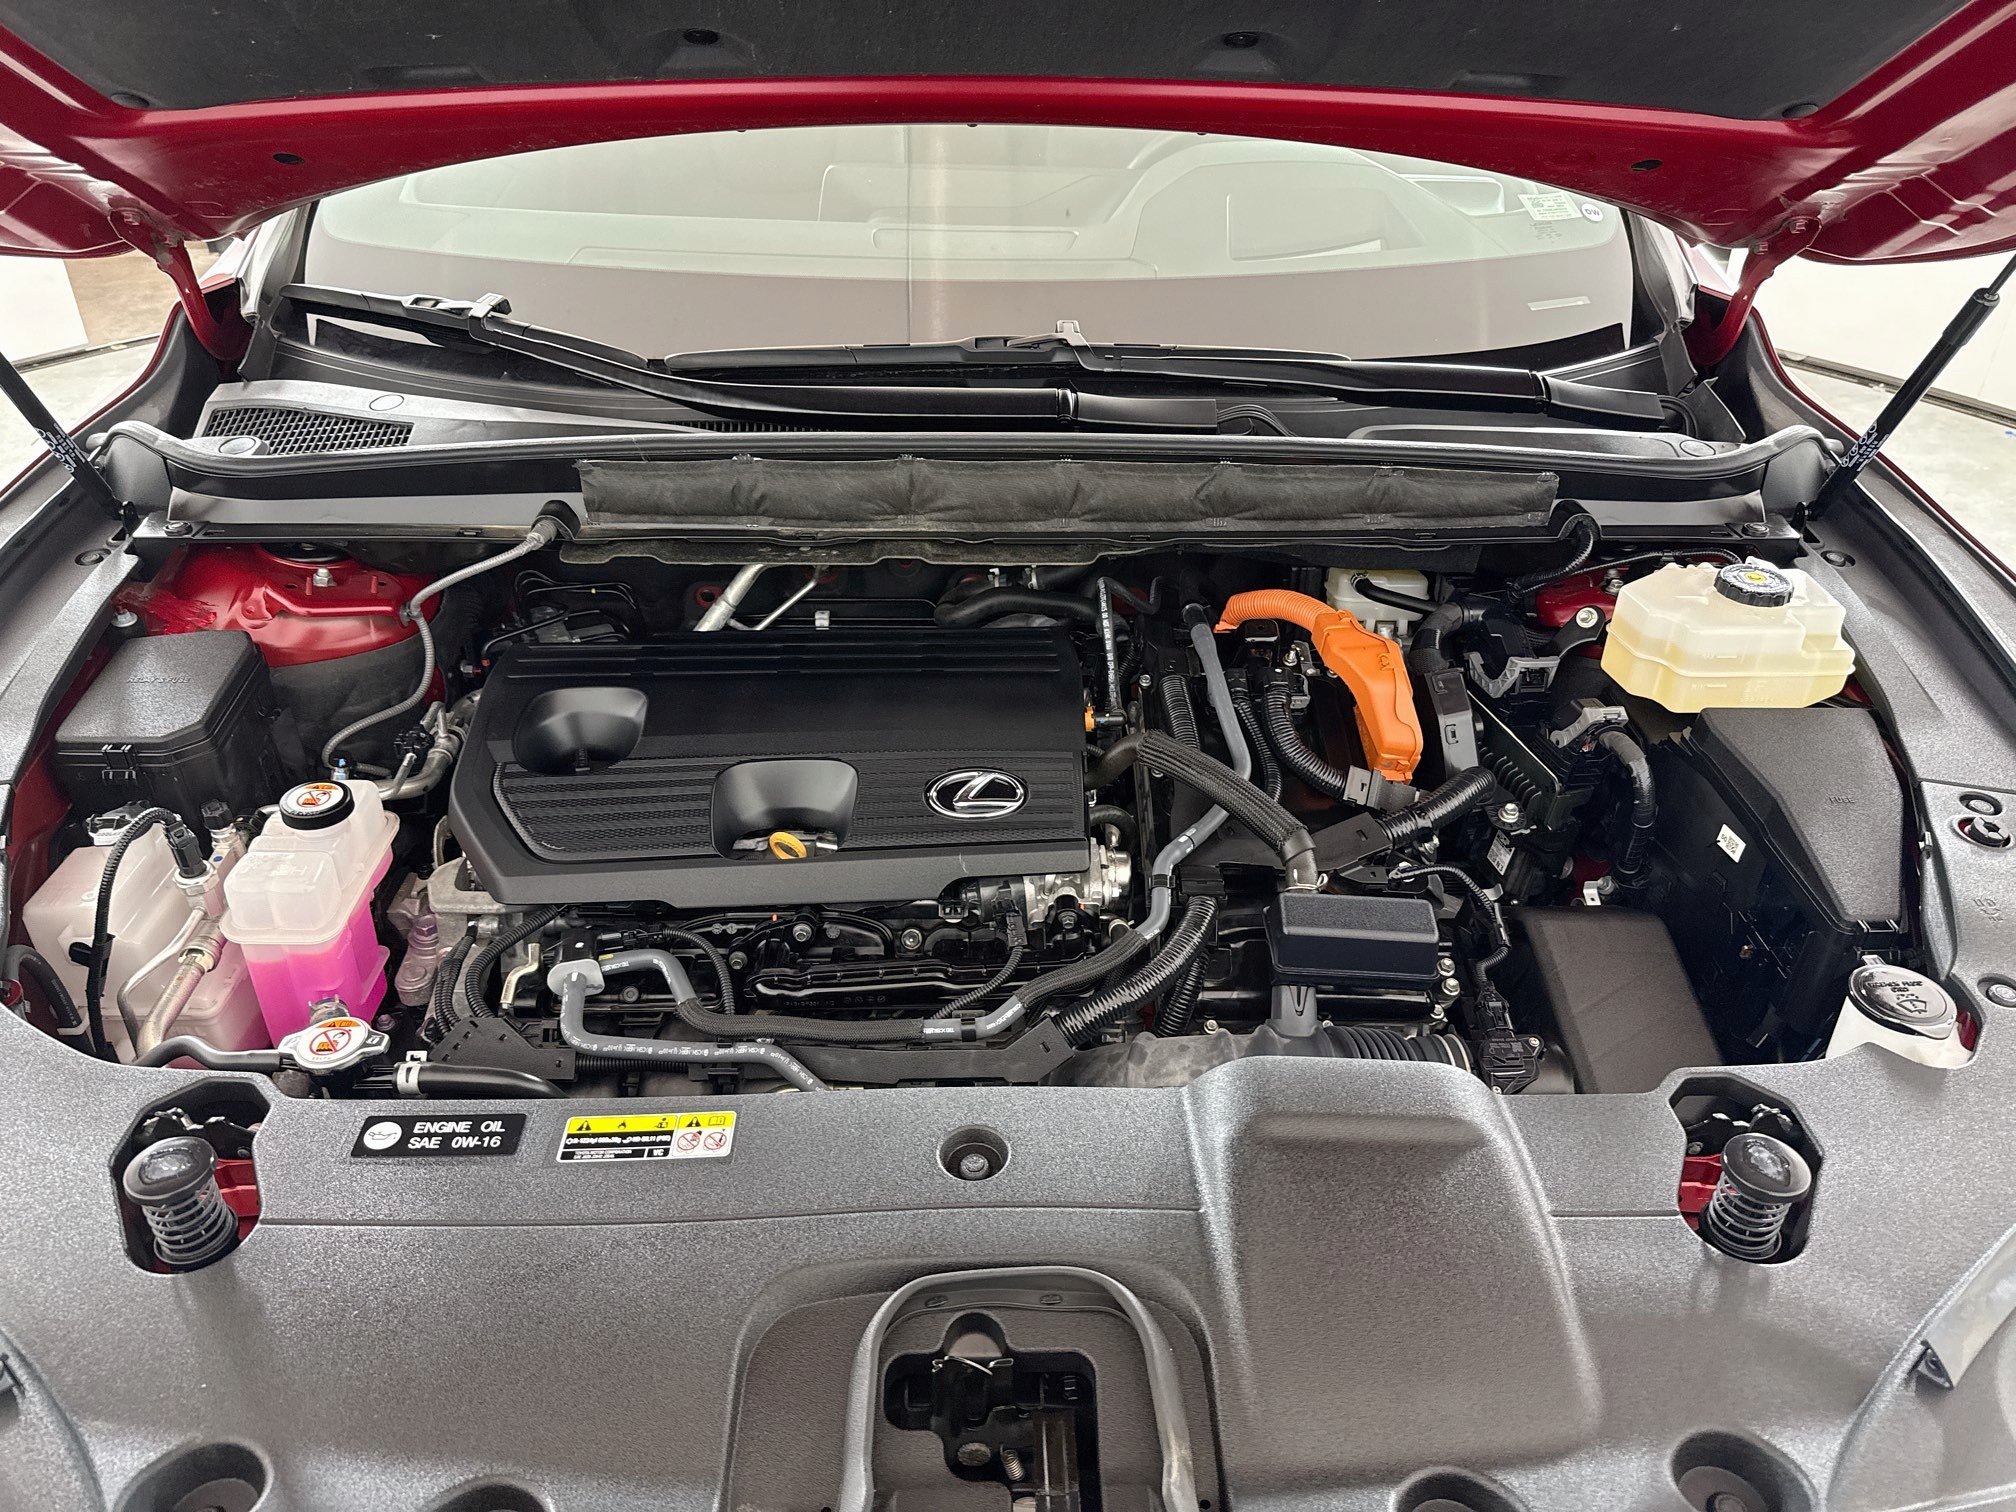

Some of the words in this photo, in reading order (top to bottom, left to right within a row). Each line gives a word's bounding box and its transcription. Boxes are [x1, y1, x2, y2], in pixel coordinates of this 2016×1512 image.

[1584, 208, 1599, 216] DW
[413, 1121, 472, 1133] ENGINE
[480, 1120, 506, 1133] OIL
[407, 1136, 443, 1149] SAE
[451, 1135, 502, 1148] 0W-16
